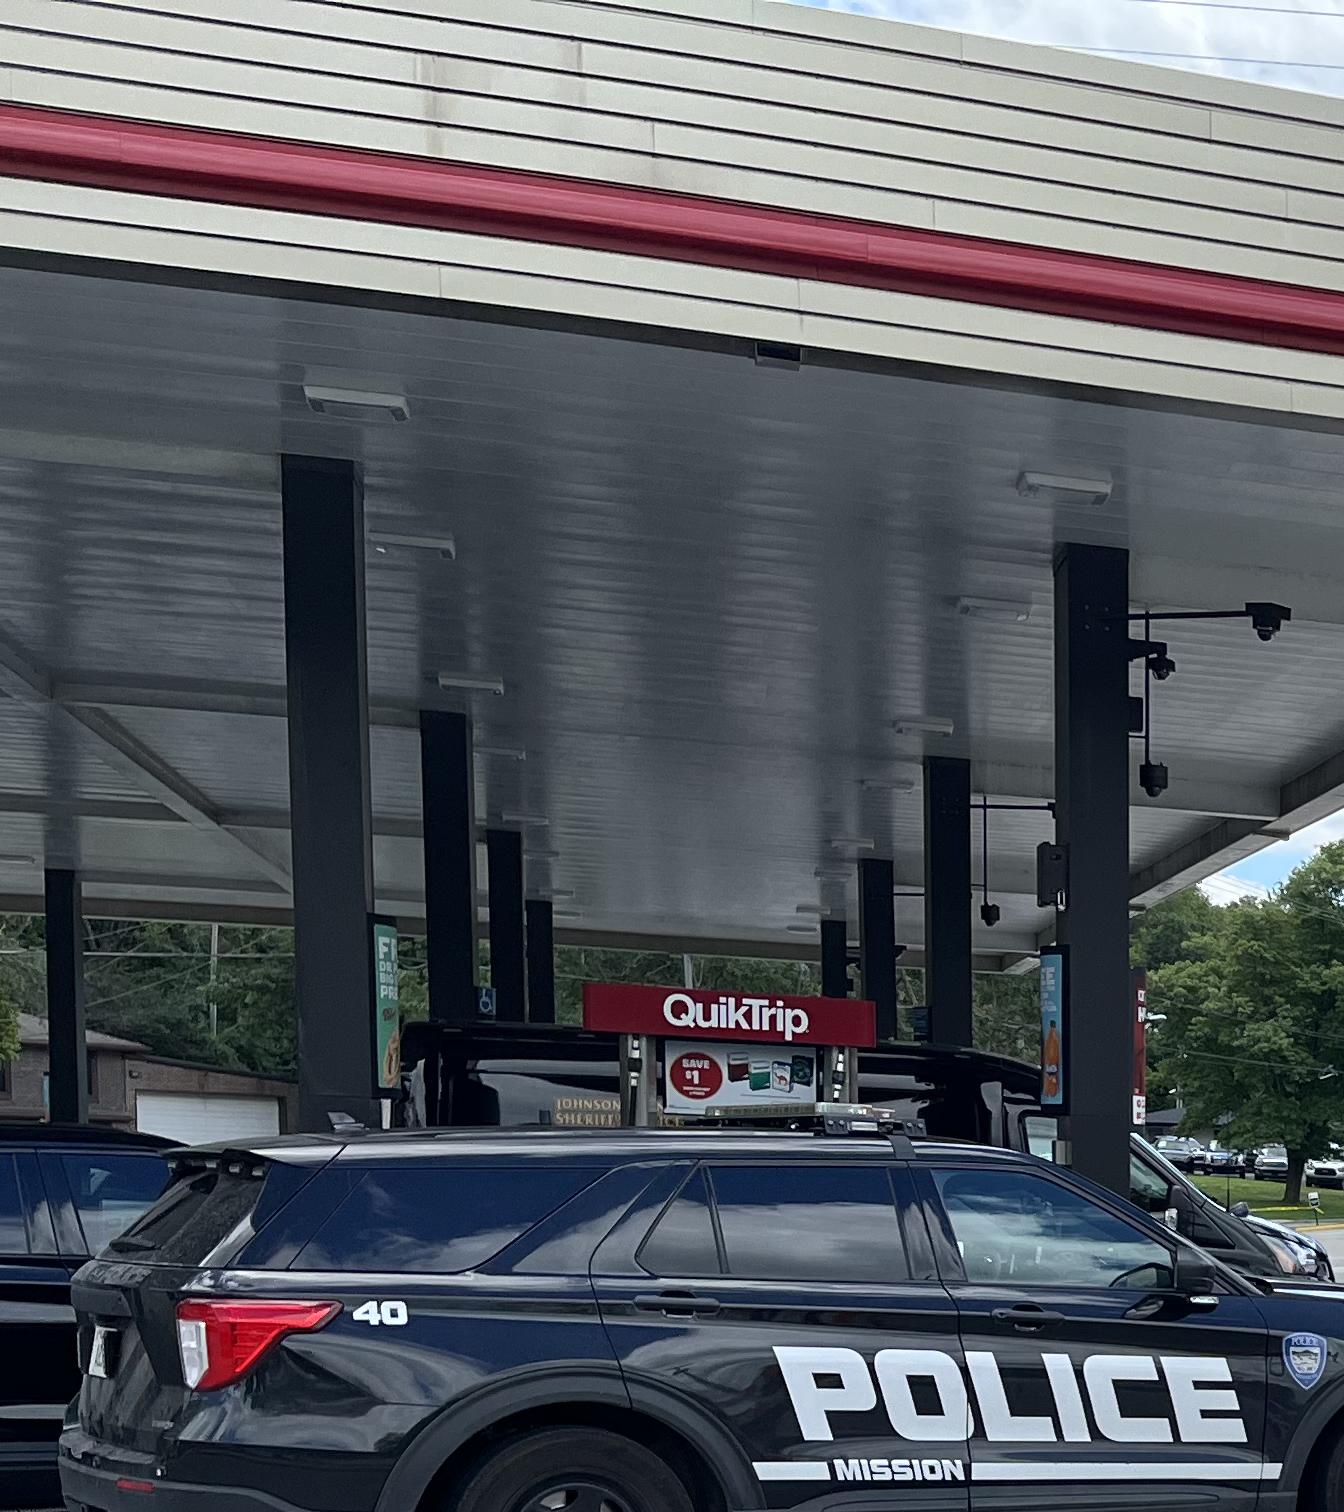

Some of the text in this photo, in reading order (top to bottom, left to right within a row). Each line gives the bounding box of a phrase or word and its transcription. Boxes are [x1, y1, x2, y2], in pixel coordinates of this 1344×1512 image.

[663, 993, 809, 1041] QuikTrip
[682, 1059, 710, 1069] SAVE
[685, 1070, 699, 1084] $1
[556, 1098, 621, 1110] JOHNSON
[353, 1301, 408, 1326] 40
[772, 1346, 1248, 1443] POLICE
[833, 1459, 966, 1481] MISSION
